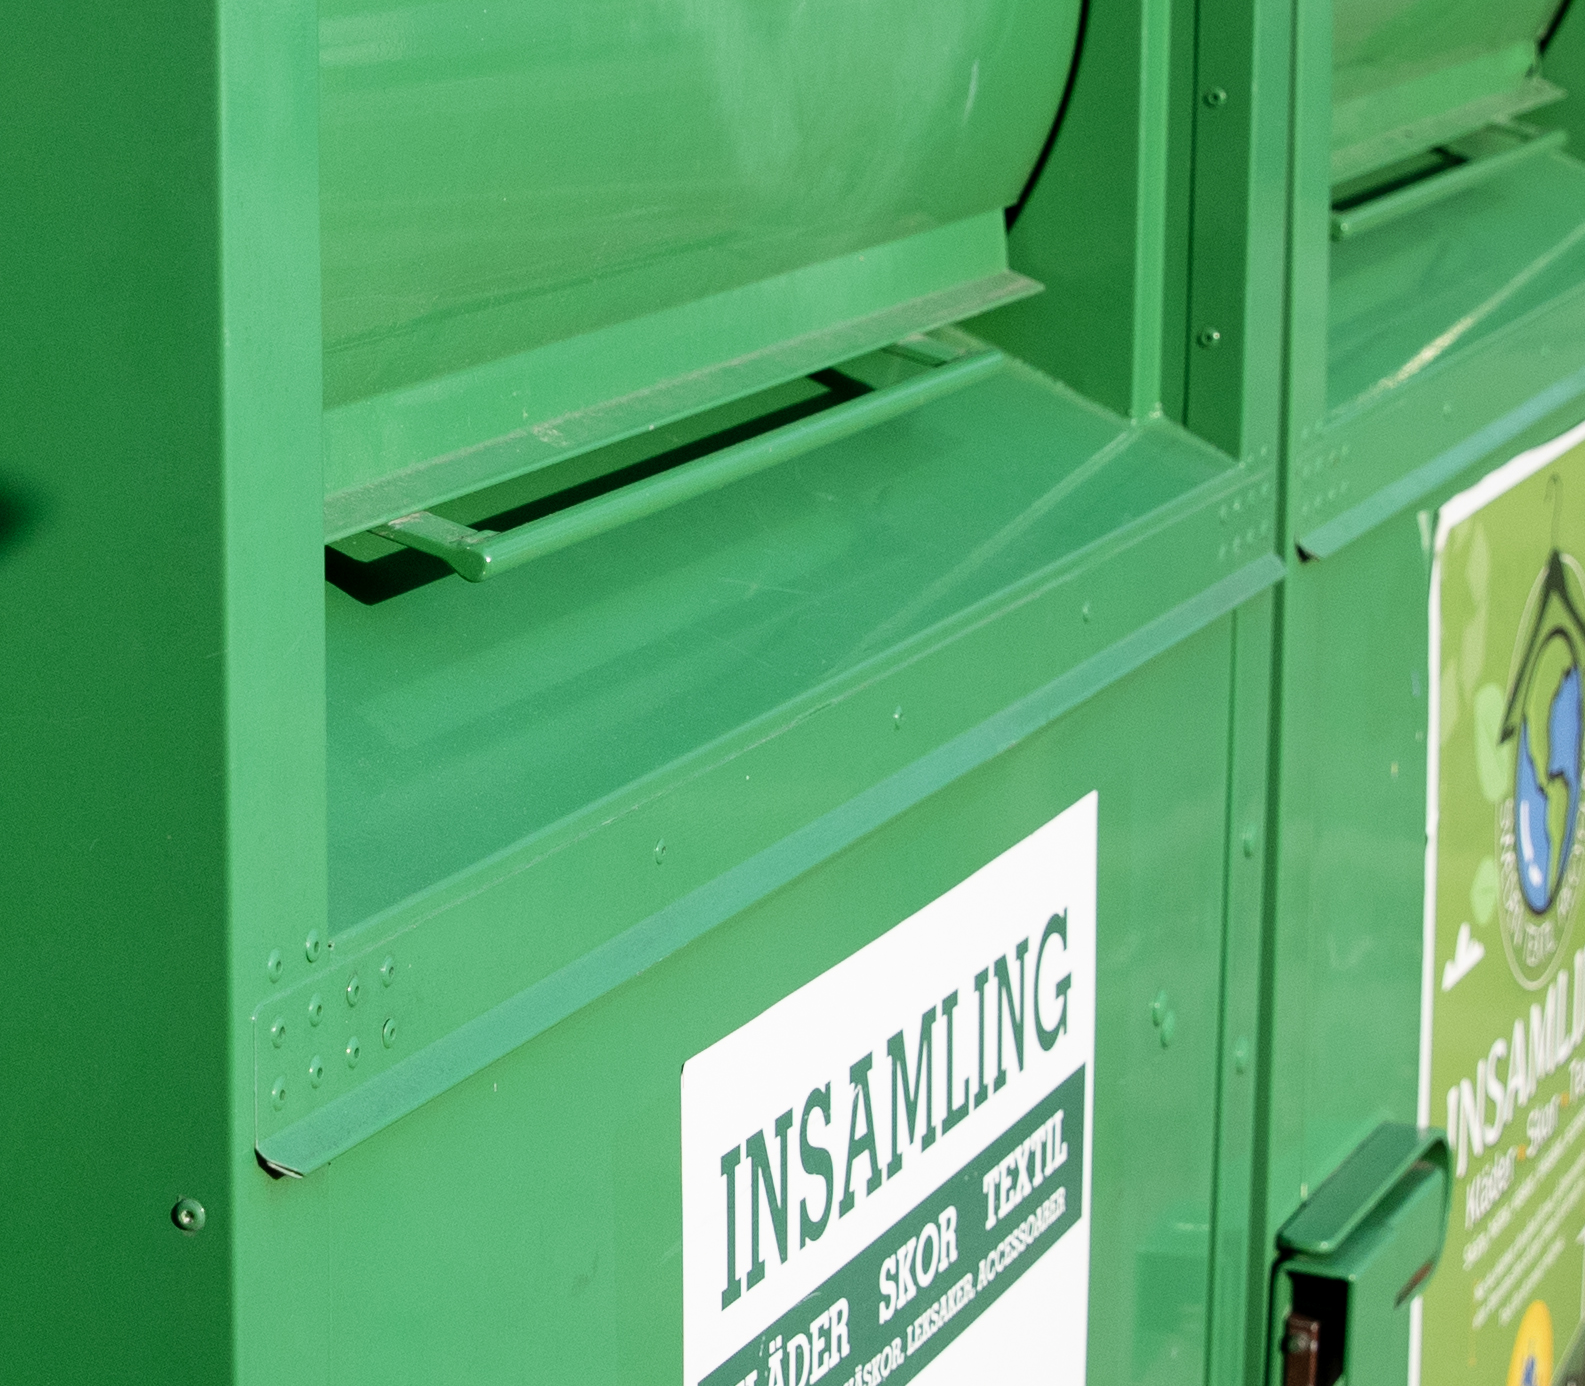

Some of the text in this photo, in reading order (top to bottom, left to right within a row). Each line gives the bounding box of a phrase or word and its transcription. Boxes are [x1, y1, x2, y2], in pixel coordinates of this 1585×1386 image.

[721, 907, 1072, 1312] INSAMLING
[879, 1205, 958, 1324] SKOR
[983, 1109, 1068, 1231] TEXTIL
